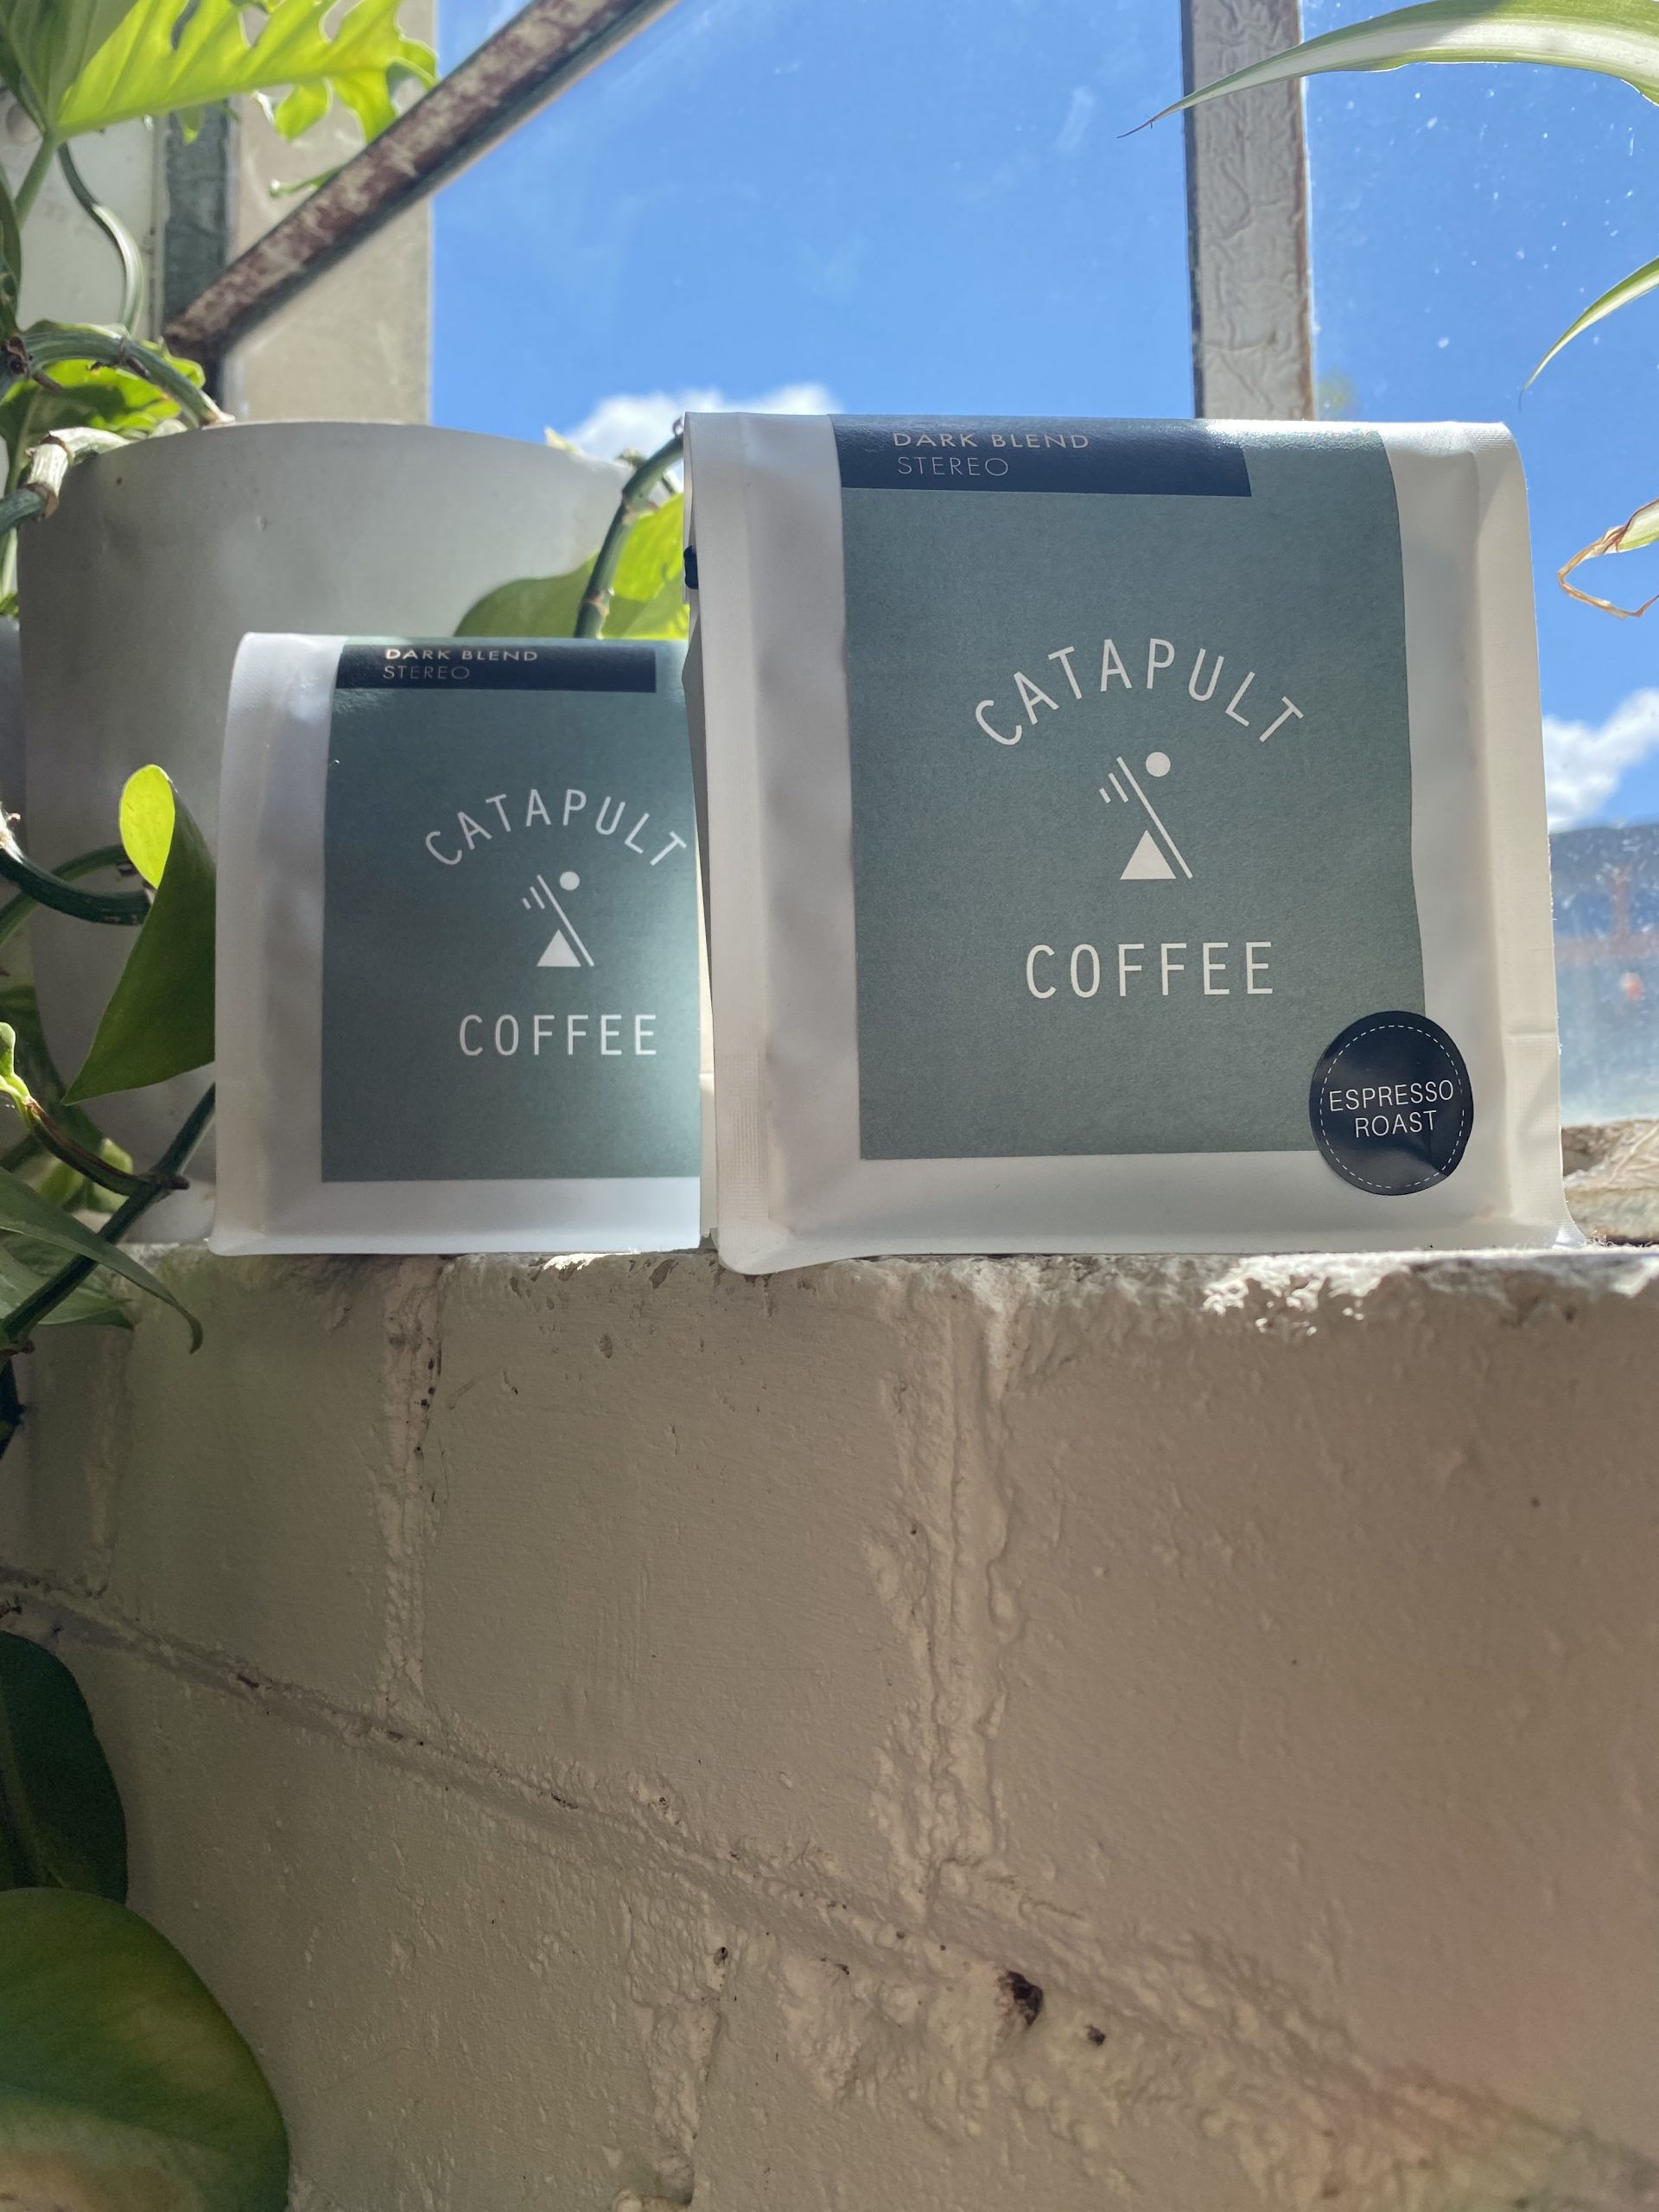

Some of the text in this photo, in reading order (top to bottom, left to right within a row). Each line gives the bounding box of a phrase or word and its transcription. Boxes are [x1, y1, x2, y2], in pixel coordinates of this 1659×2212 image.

[893, 431, 1090, 450] DARK BLEND
[897, 456, 1009, 477] STEREO
[385, 648, 538, 662] DARK BLEND
[383, 665, 470, 680] STEREO
[975, 638, 1304, 746] CATAPULT
[425, 789, 688, 866] CATAPULT
[1026, 941, 1274, 999] COFFEE
[459, 1014, 657, 1056] COFFEE
[1328, 1079, 1454, 1112] ESPRESSO
[1354, 1109, 1437, 1139] ROAST
